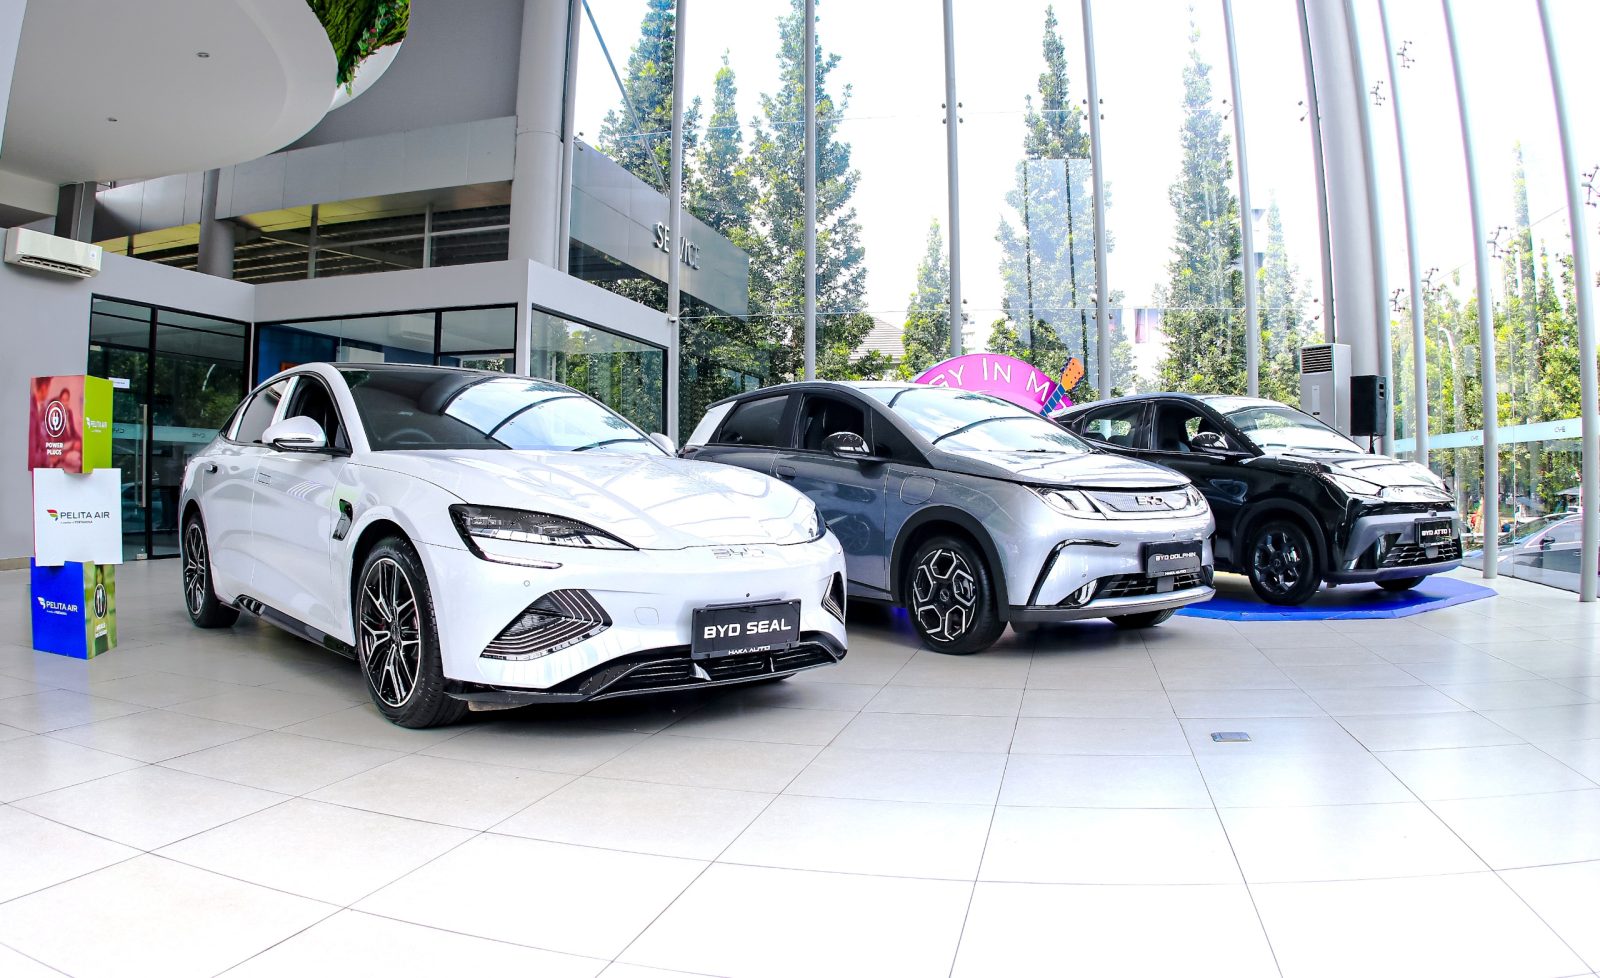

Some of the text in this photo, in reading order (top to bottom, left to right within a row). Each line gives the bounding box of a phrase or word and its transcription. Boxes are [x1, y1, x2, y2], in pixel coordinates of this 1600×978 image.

[655, 221, 700, 269] SEVICE
[981, 357, 1012, 384] IN
[60, 511, 110, 520] PELITA AIR
[1434, 528, 1448, 536] ATTO
[1170, 552, 1197, 560] DOLPHIN
[45, 600, 67, 611] PELITA
[67, 604, 78, 613] AIR
[704, 618, 792, 639] BYD SEAL
[728, 645, 771, 656] HAKA AUTO
